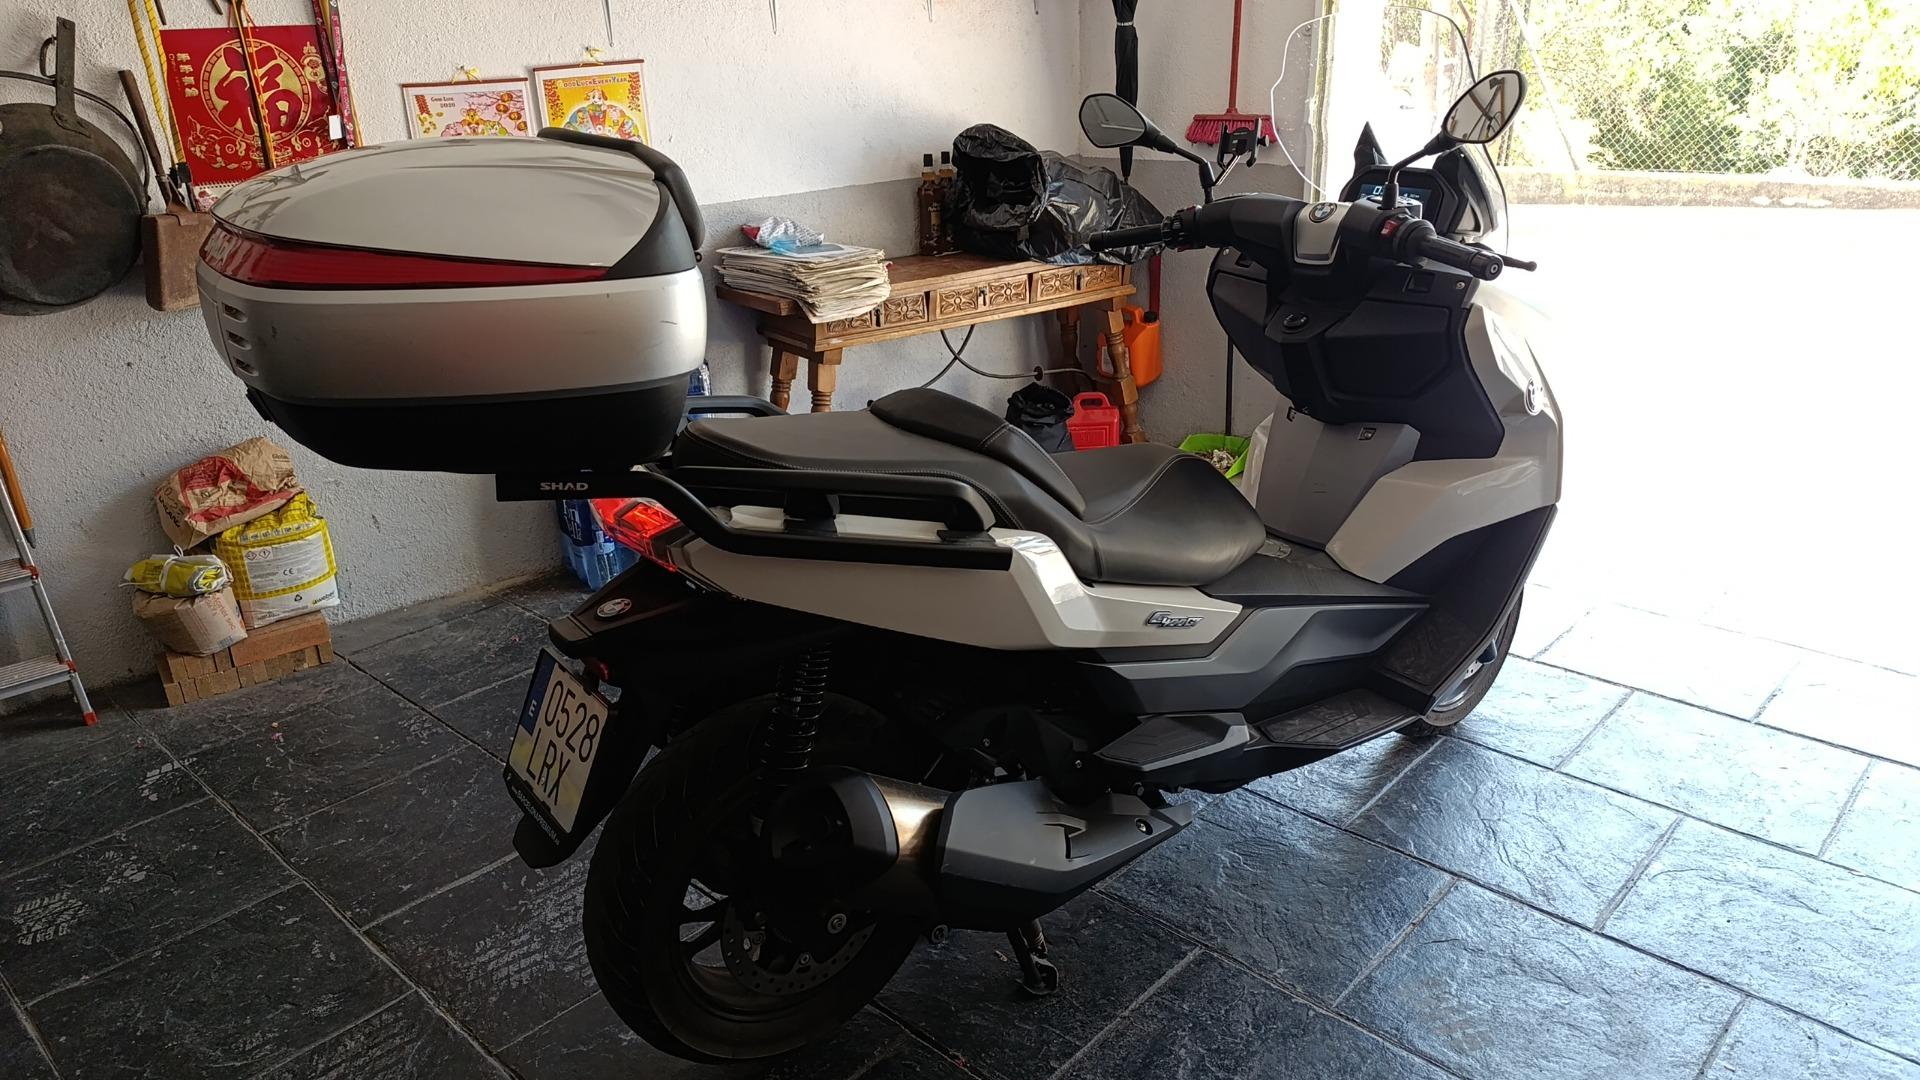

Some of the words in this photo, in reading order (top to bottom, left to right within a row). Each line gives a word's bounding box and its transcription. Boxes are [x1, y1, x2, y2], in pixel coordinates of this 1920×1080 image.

[540, 482, 589, 491] SHAD
[528, 700, 538, 717] E
[544, 680, 600, 763] 0528
[526, 727, 571, 806] LRX
